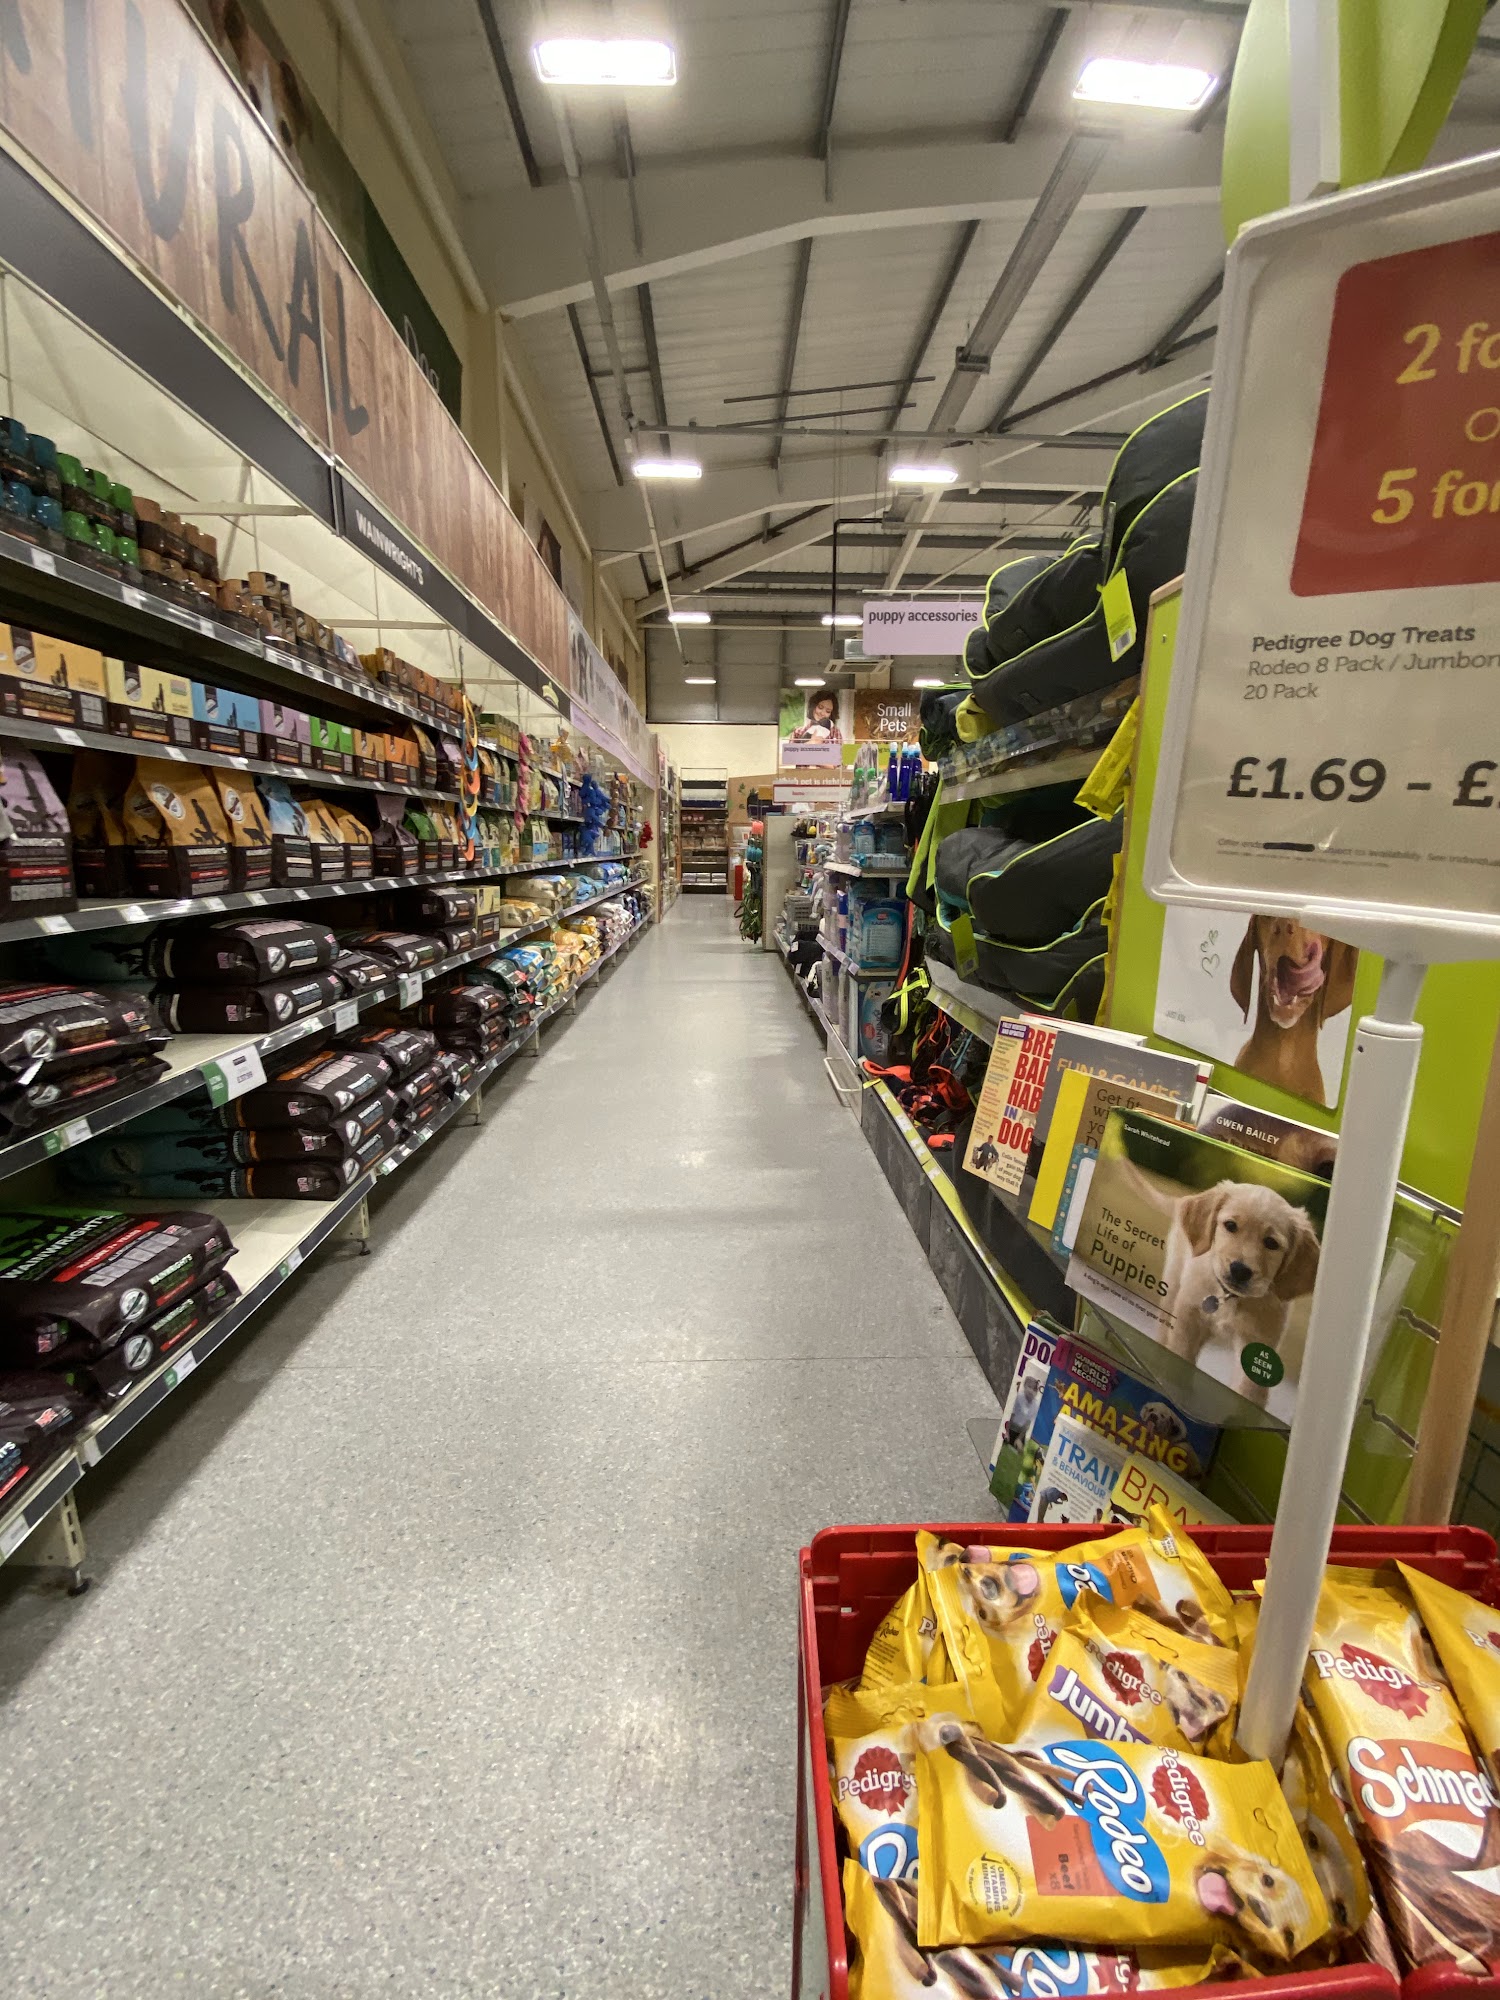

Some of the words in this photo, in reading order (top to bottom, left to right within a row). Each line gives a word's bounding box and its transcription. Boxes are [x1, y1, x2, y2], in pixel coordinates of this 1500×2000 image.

[1396, 323, 1439, 385] 2
[1371, 467, 1417, 525] 5
[869, 610, 905, 625] puppy
[908, 609, 978, 622] accessories
[1252, 633, 1342, 654] Pedigree
[1349, 629, 1395, 649] Dog
[1402, 625, 1476, 645] Treats
[1248, 660, 1310, 676] Rodeo
[1315, 659, 1328, 673] 8
[1335, 655, 1383, 672] Pack
[1243, 684, 1268, 700] 20
[1273, 682, 1319, 699] Pack
[877, 702, 912, 717] Small
[880, 718, 907, 732] Pets
[1226, 756, 1387, 803] £1.69
[1004, 1105, 1018, 1121] IN
[1096, 1088, 1121, 1107] Get
[1124, 1123, 1140, 1136] Sarah
[1140, 1129, 1171, 1147] Whitehead
[1216, 1116, 1244, 1132] GWEN
[1245, 1126, 1280, 1145] BAILEY
[1096, 1223, 1119, 1244] Life
[1122, 1239, 1137, 1253] of
[1101, 1207, 1122, 1227] The
[1123, 1219, 1166, 1251] Secret
[0, 1214, 115, 1279] WAINWRIGHT'S
[1090, 1240, 1170, 1297] Puppies
[1024, 1333, 1055, 1365] DO
[1075, 1352, 1111, 1376] GUINNESS
[1253, 1356, 1273, 1371] SEEN
[1259, 1350, 1270, 1360] AS
[1071, 1365, 1107, 1392] RECORDS
[1073, 1358, 1109, 1383] WORLD
[1251, 1365, 1261, 1375] ON
[1262, 1370, 1272, 1380] TV
[1062, 1382, 1188, 1473] AMAZING
[1058, 1460, 1107, 1499] BEHAVIOUR
[1122, 1465, 1202, 1526] BRA
[1084, 1637, 1163, 1706] Pedigree
[1049, 1667, 1148, 1745] Jumb
[1158, 1745, 1206, 1847] Pedigree
[1052, 1747, 1156, 1894] Rodeo
[997, 1866, 1008, 1902] OMEGA
[1058, 1853, 1075, 1890] Beef
[981, 1863, 993, 1915] MINERALS
[990, 1864, 1001, 1912] VITAMINS
[1002, 1903, 1009, 1911] 3
